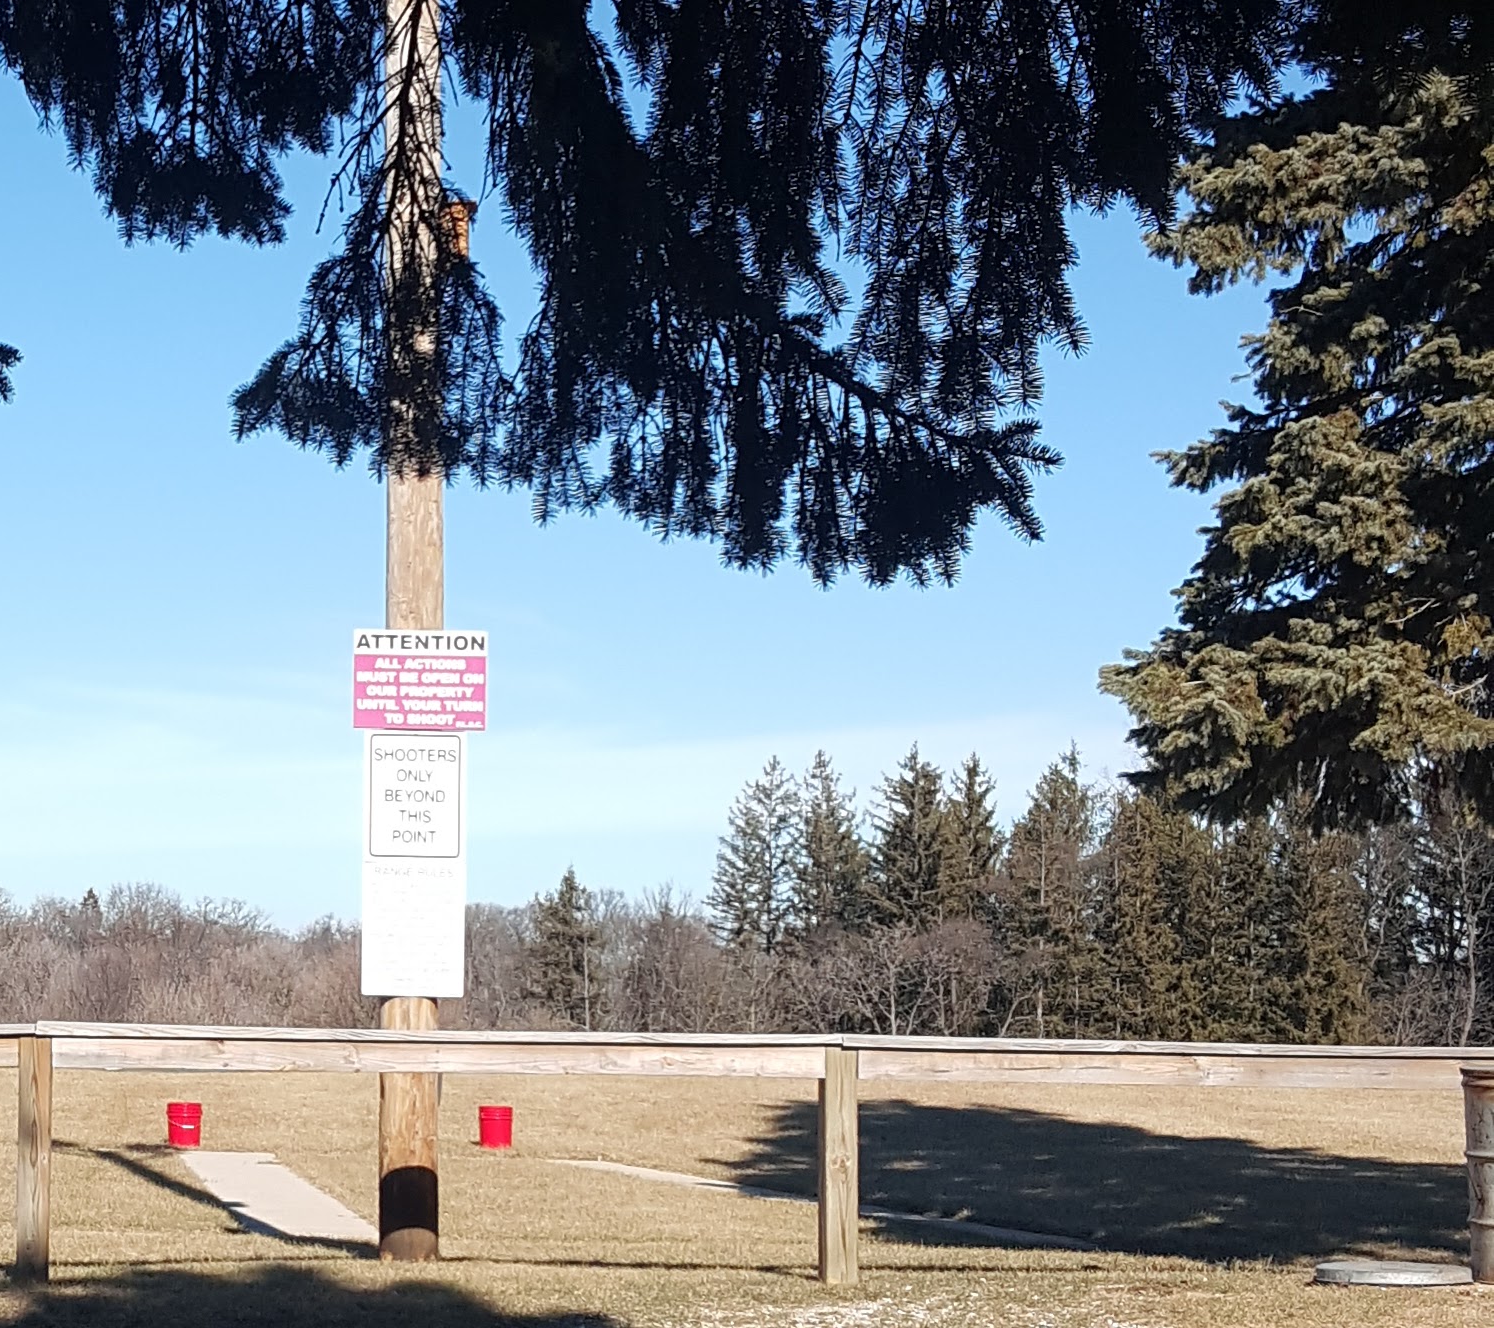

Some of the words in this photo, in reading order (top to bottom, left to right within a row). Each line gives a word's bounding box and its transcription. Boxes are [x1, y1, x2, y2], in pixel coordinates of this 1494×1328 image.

[356, 634, 485, 651] ATTENTION
[375, 658, 402, 669] ALL
[404, 658, 466, 670] ACTIONS
[366, 685, 397, 696] OUR
[400, 685, 474, 697] PROPERTY
[356, 699, 399, 710] UNTIL
[402, 699, 441, 711] YOUR
[444, 700, 483, 711] TURN
[384, 713, 404, 724] TO
[407, 713, 455, 725] SHOOT
[374, 748, 457, 763] SHOOTERS
[396, 768, 433, 782] ONLY
[384, 789, 446, 803] BEYOND
[399, 809, 432, 823] THIS
[392, 830, 436, 843] POINT
